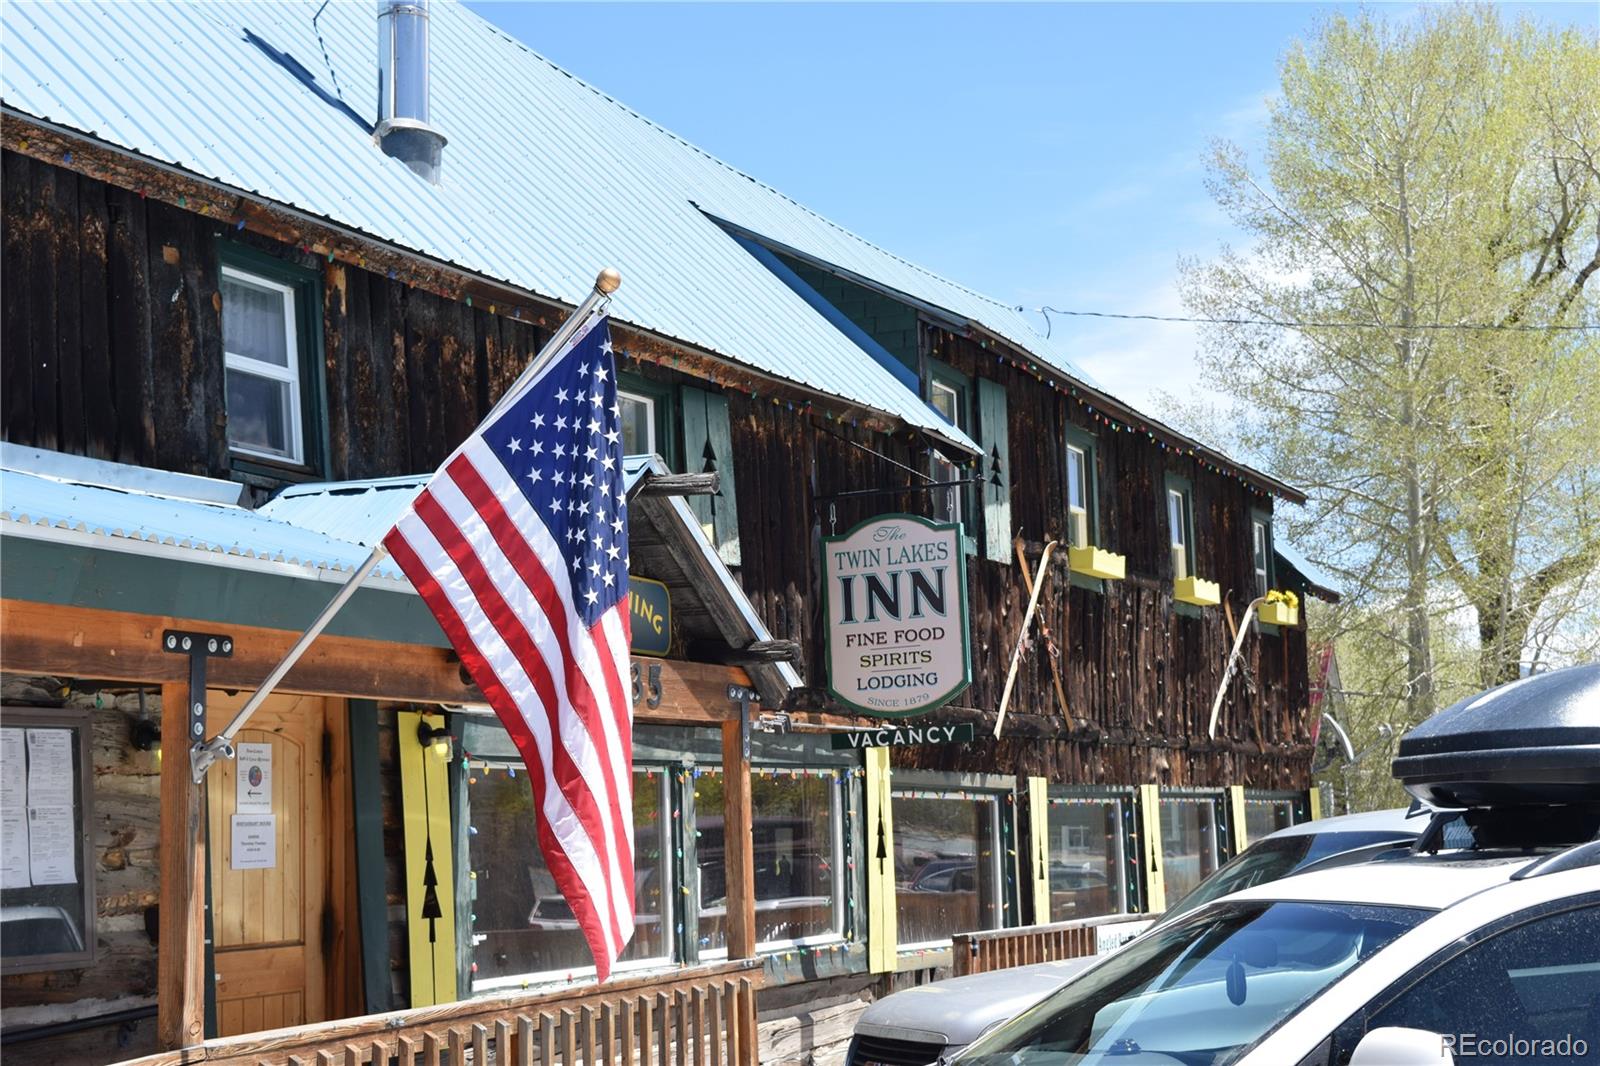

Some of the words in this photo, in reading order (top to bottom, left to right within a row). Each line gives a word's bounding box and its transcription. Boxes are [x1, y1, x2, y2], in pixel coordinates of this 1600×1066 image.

[873, 526, 906, 542] The
[835, 548, 881, 570] TWIN
[888, 542, 948, 567] LAKES
[837, 566, 948, 625] INN
[846, 632, 887, 648] FINE
[894, 627, 945, 643] FOOD
[860, 650, 932, 668] SPIRITS
[857, 672, 938, 690] LODGING
[867, 696, 900, 708] SINCE
[904, 692, 930, 706] 1879
[848, 726, 956, 748] VACANCY
